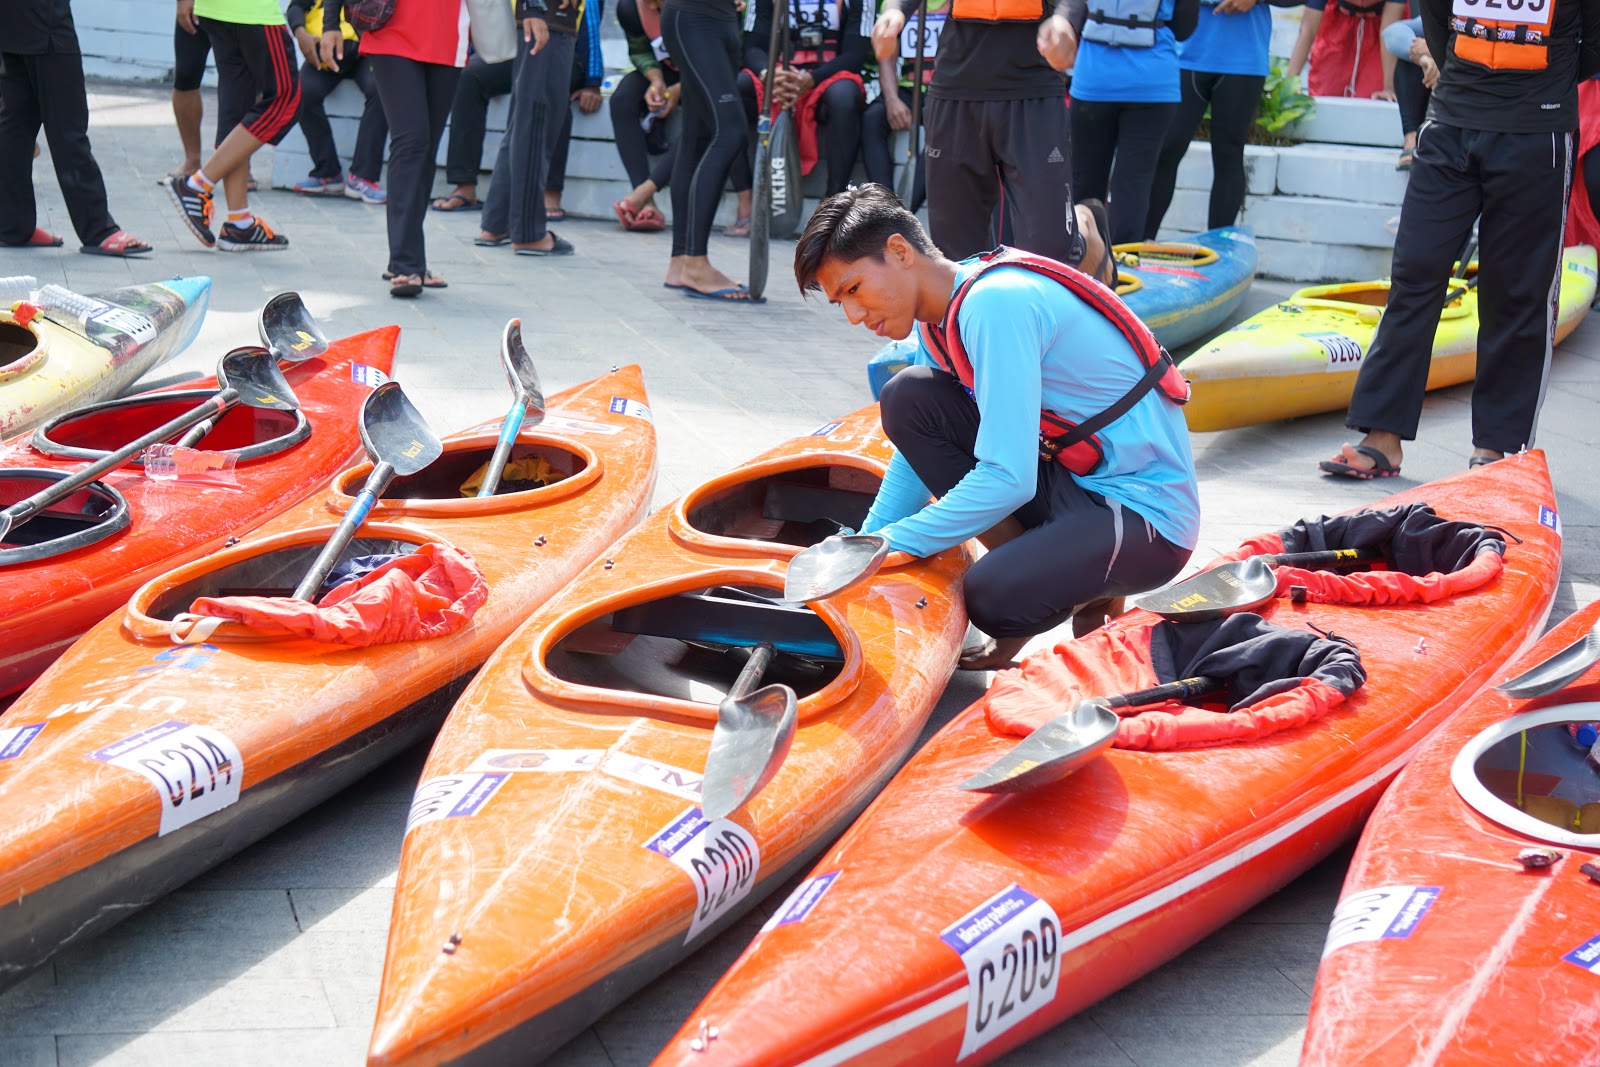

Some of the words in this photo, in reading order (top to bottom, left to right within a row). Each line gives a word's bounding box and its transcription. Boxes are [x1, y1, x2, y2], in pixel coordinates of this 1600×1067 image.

[771, 157, 786, 216] VIKING
[1318, 337, 1361, 362] D205
[46, 696, 188, 719] UTM
[137, 735, 233, 808] C214
[690, 829, 753, 921] C210
[975, 917, 1057, 1033] C209
